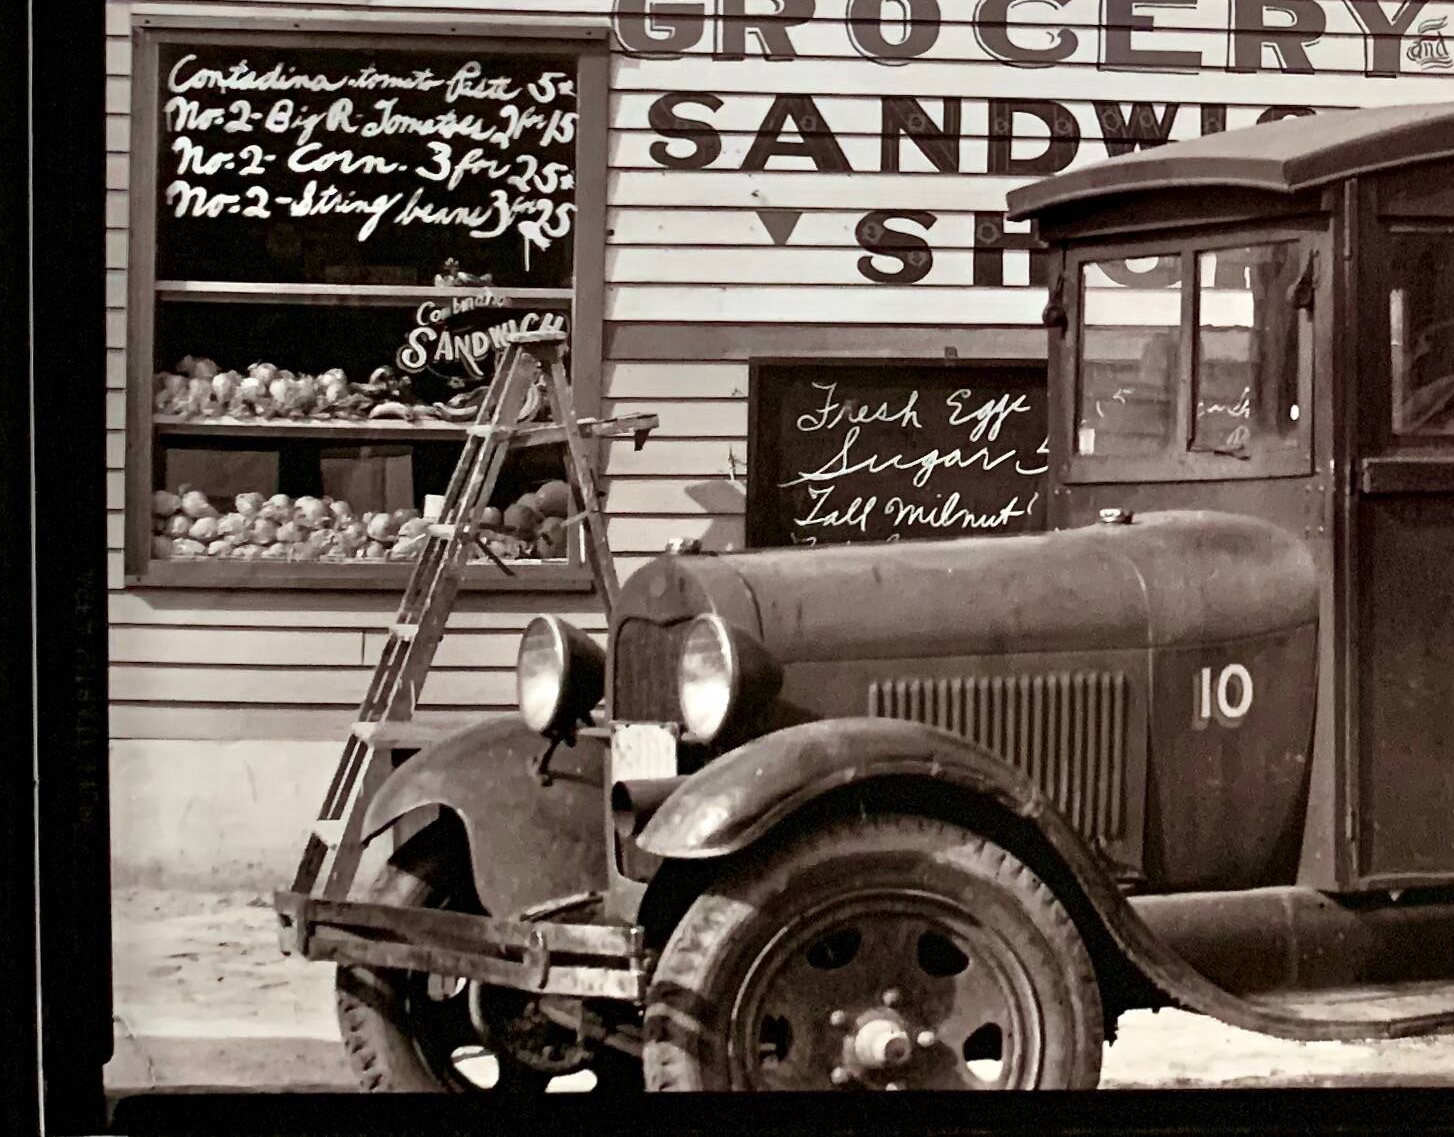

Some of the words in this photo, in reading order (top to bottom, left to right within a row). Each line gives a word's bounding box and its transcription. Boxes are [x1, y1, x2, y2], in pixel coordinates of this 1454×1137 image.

[647, 92, 1318, 174] SANDW
[797, 382, 923, 432] Fresh
[777, 425, 1017, 488] Sugar
[1197, 664, 1254, 724] 10
